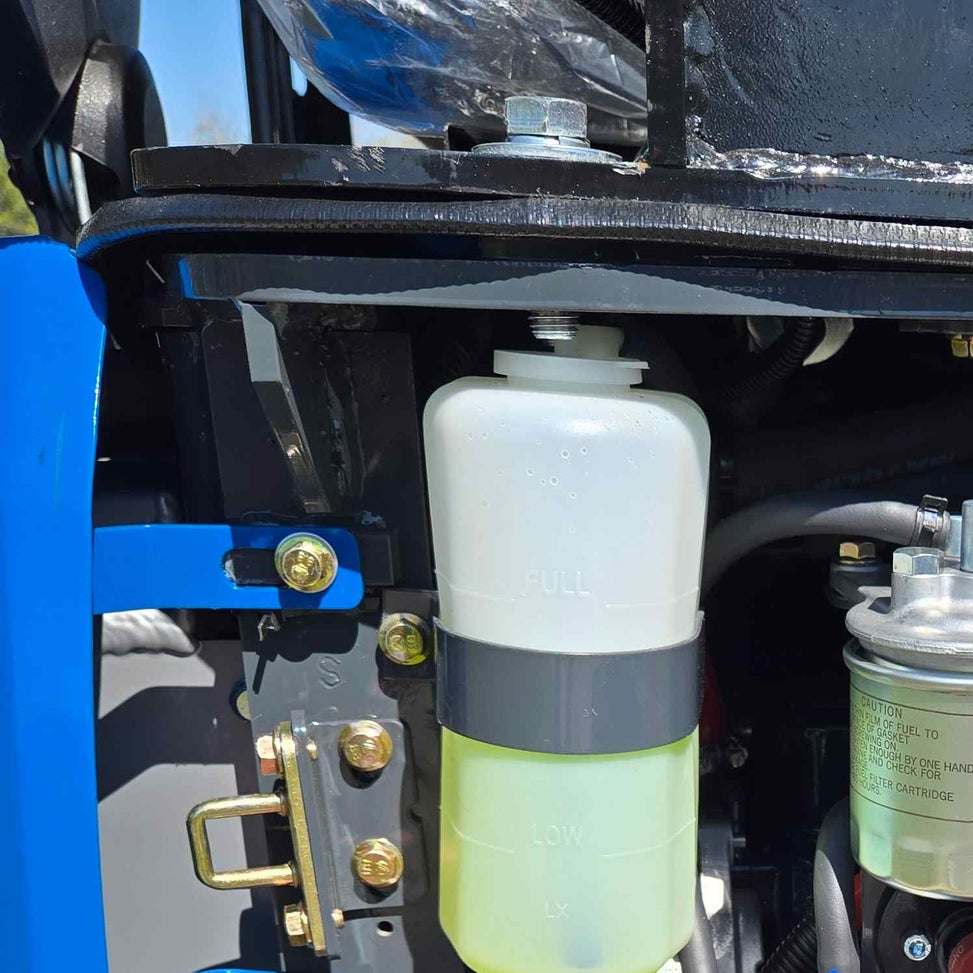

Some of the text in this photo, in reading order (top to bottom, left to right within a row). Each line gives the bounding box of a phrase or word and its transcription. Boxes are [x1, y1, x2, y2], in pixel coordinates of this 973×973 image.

[526, 568, 591, 596] FULL
[861, 696, 903, 719] CAUTION
[864, 711, 881, 726] FILM
[883, 719, 895, 731] OF
[896, 723, 921, 737] FUEL
[924, 728, 939, 740] TO
[876, 728, 911, 745] GASKET
[868, 754, 884, 767] AND
[885, 760, 918, 777] CHECK
[920, 768, 941, 780] FOR
[869, 744, 902, 762] ENOUGH
[904, 754, 917, 766] BY
[919, 758, 941, 770] ONE
[869, 773, 893, 789] FILTER
[895, 782, 955, 802] CARTRIDGE
[531, 820, 584, 848] LOW
